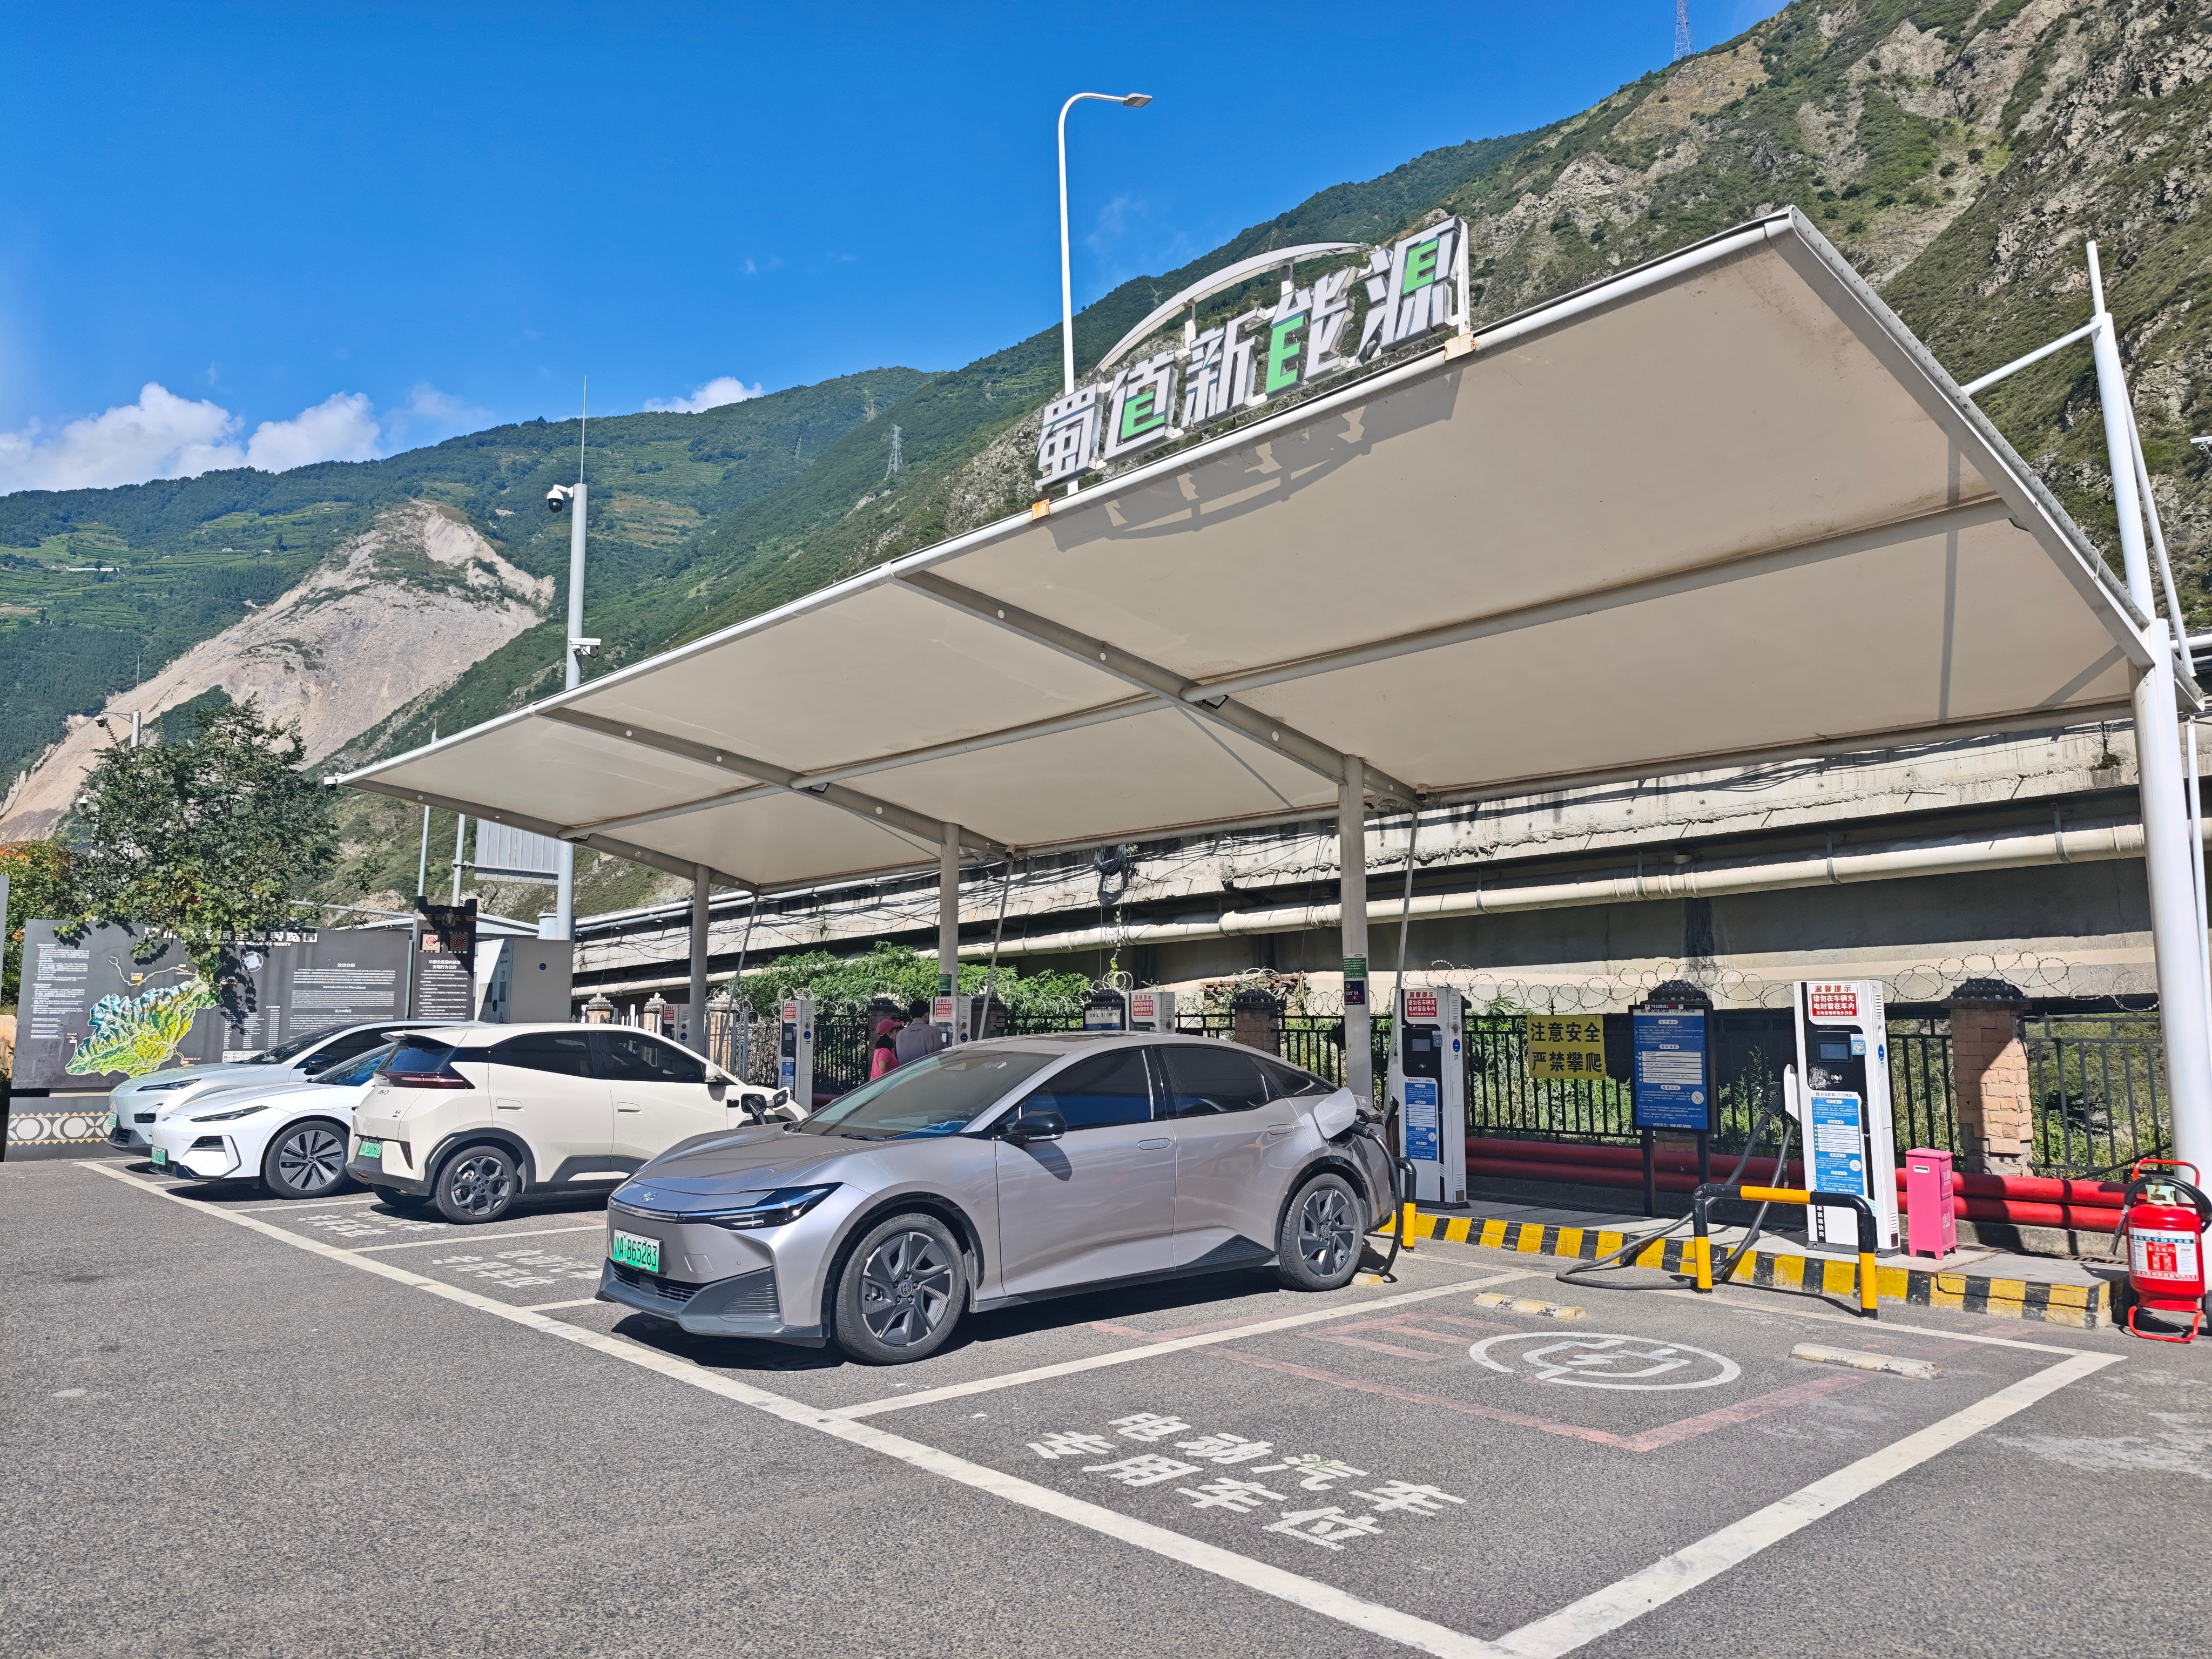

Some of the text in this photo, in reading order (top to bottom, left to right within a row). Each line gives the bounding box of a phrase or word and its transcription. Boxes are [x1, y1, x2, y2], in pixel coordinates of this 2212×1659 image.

[1035, 216, 1460, 490] 蜀道新能源
[1530, 1022, 1600, 1042] 注意安全
[1532, 1051, 1602, 1073] 严禁攀爬
[1026, 1431, 1384, 1551] 专用车位
[1109, 1412, 1468, 1516] 电动汽车
